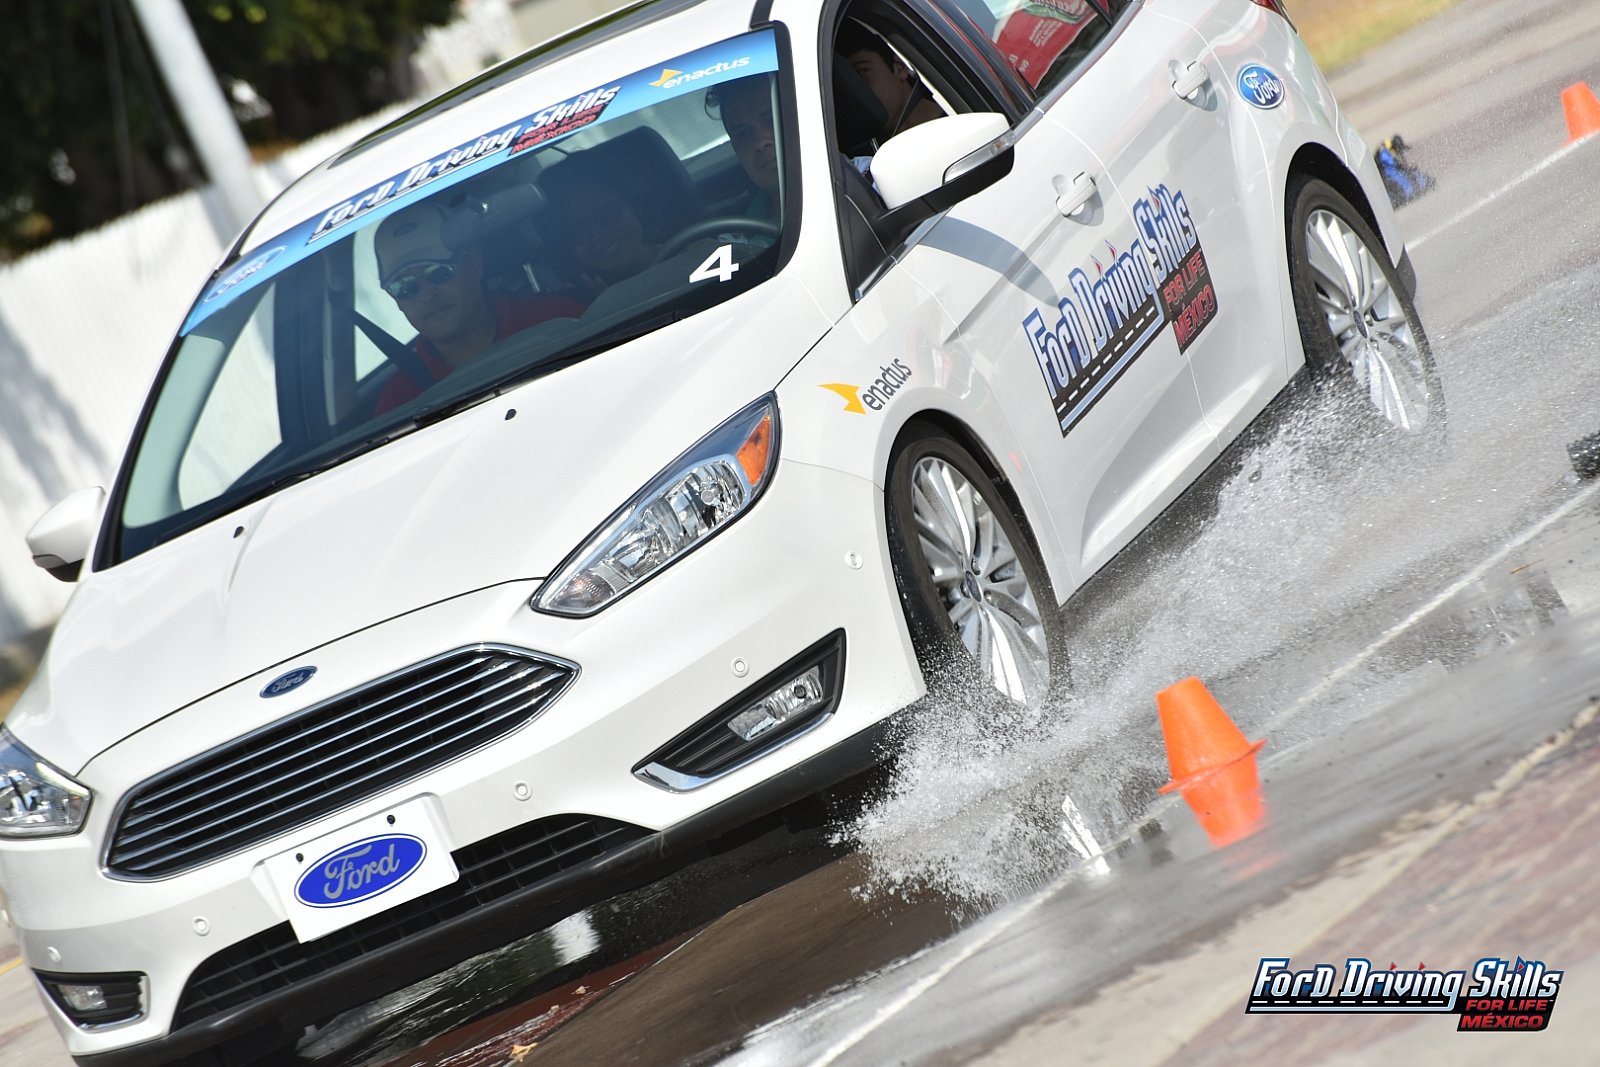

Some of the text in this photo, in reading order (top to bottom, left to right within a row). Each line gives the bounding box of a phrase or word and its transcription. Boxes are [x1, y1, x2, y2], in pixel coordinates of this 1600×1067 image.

[662, 56, 751, 89] enactus
[1243, 70, 1280, 105] Ford
[396, 124, 522, 194] Driving
[523, 85, 621, 135] Skills
[688, 243, 740, 284] 4
[1068, 240, 1158, 352] Driving
[1133, 183, 1199, 286] Skills
[1163, 250, 1206, 312] FOR LIFE
[861, 358, 913, 411] enactus
[271, 671, 305, 693] Ford
[323, 843, 401, 900] Ford
